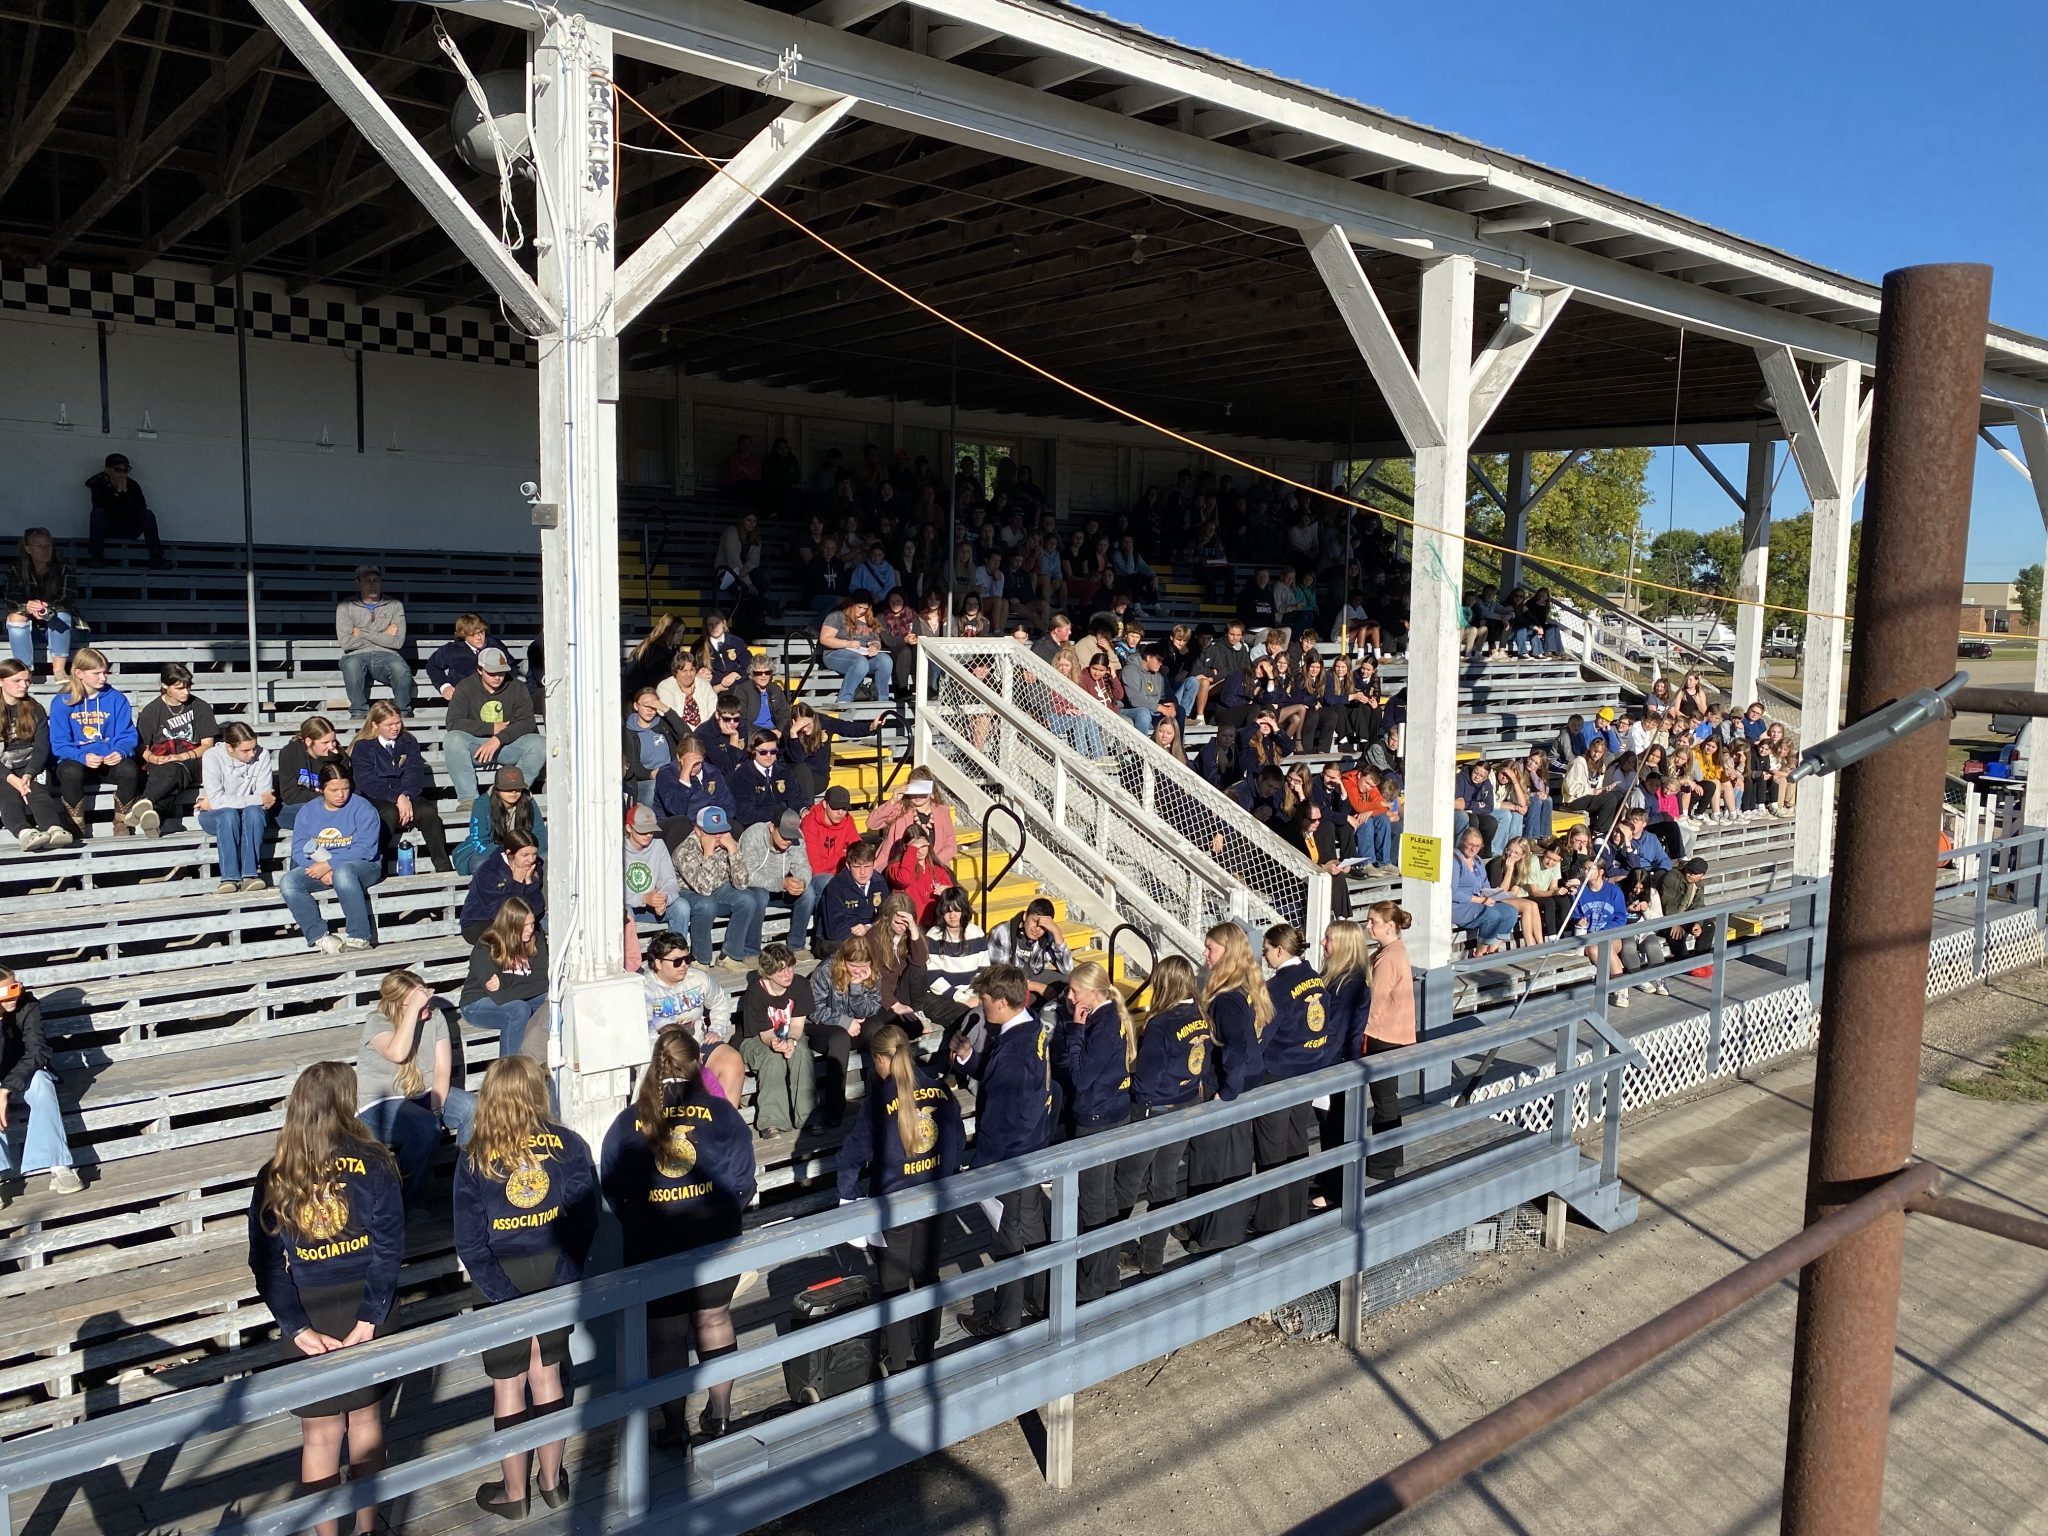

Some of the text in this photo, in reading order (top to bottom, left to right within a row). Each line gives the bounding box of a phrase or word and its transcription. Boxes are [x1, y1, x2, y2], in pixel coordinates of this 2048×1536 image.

[1410, 837, 1434, 845] PLEASE
[1176, 1019, 1208, 1042] MINNESO
[886, 1087, 948, 1115] MIESOTA
[635, 1105, 713, 1132] MNESOTA
[903, 1157, 937, 1175] REGION
[648, 1180, 714, 1203] ASSOCIATION
[492, 1205, 560, 1231] ASSOCIATION
